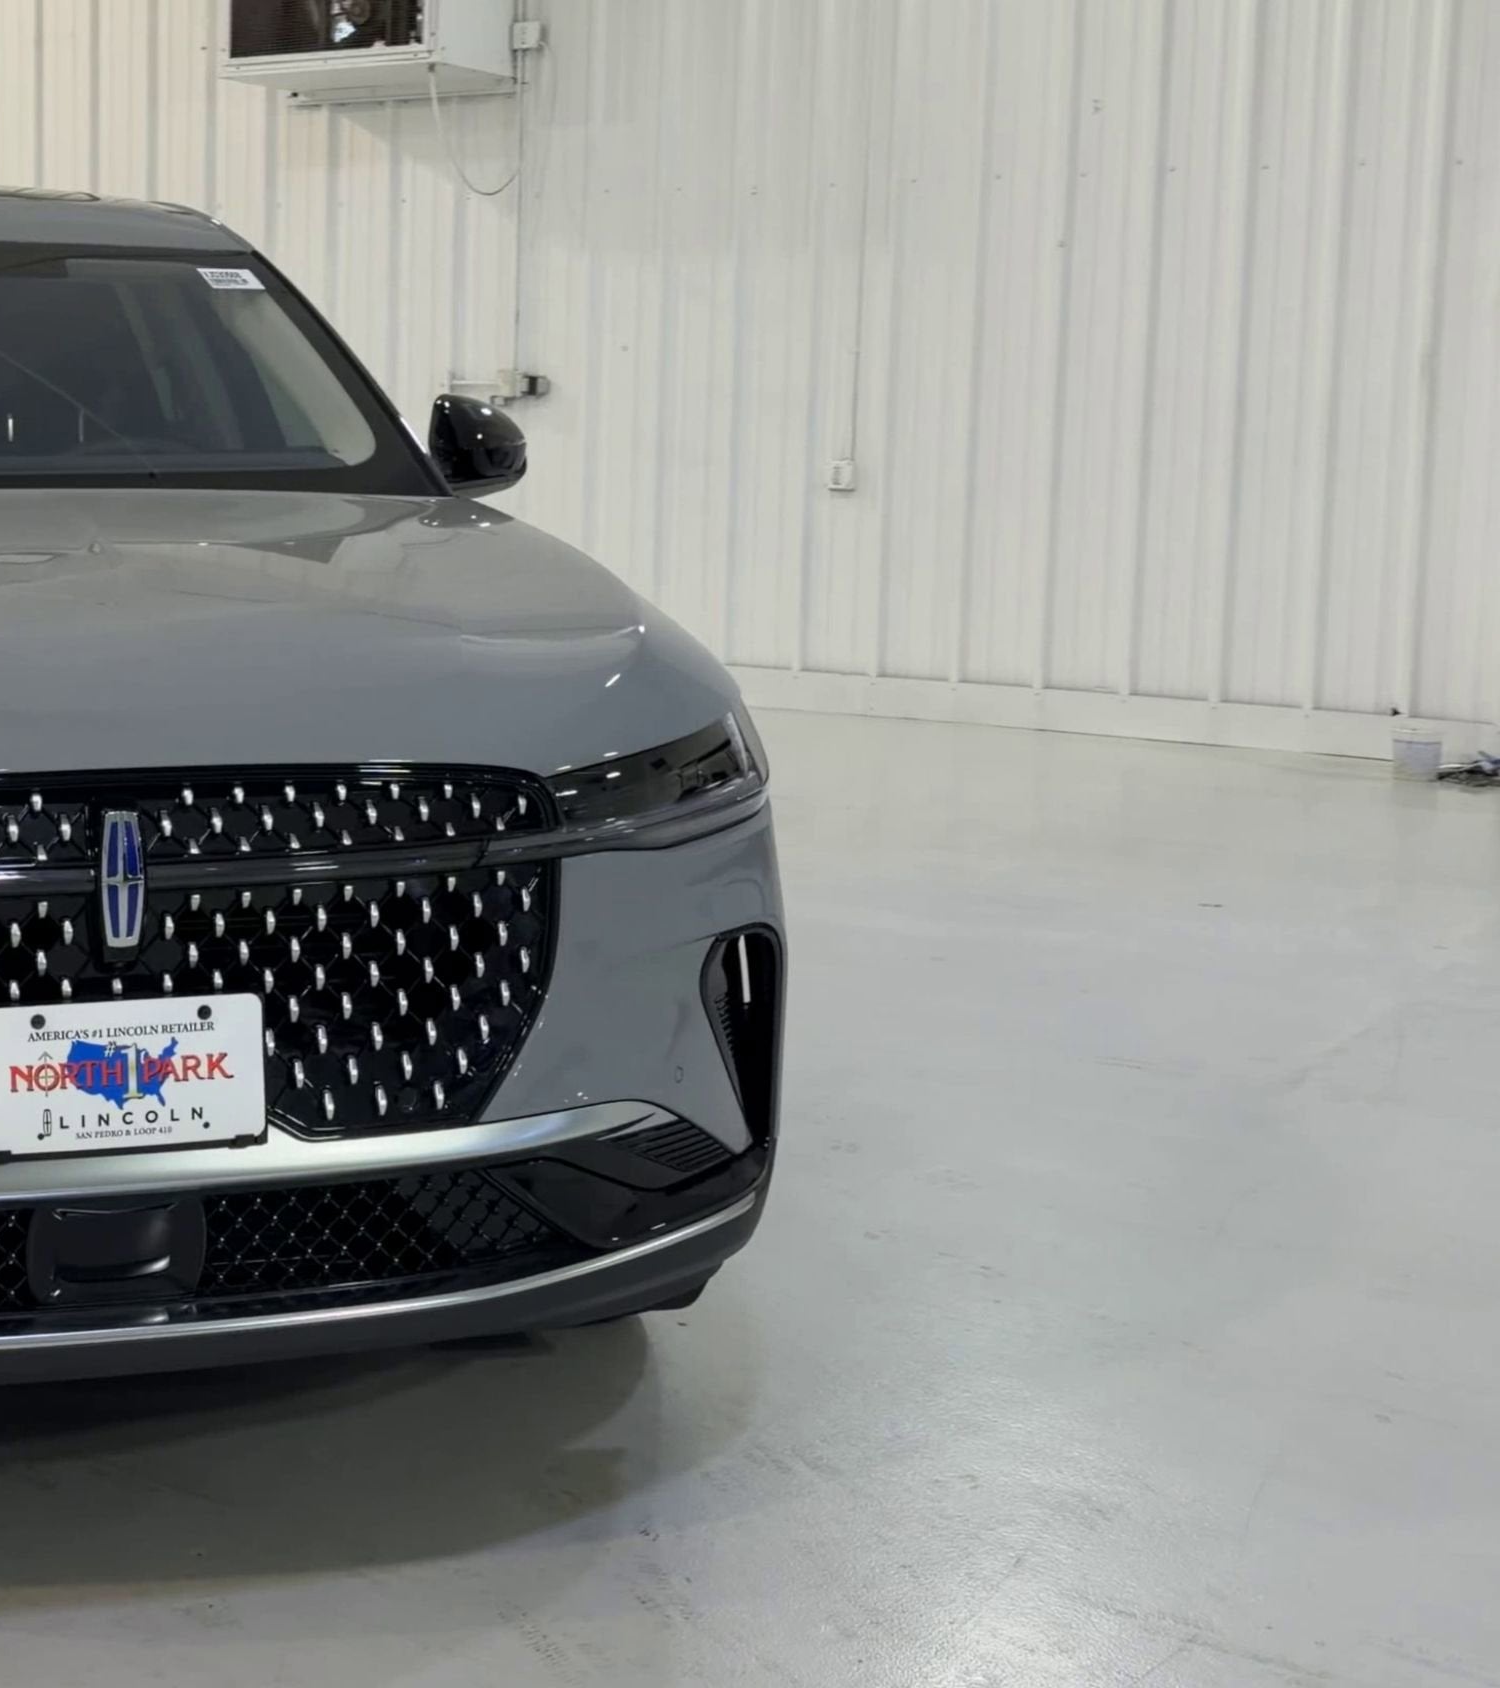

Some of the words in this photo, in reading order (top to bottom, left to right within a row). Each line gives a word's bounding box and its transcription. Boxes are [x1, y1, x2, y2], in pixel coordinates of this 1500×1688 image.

[27, 1028, 90, 1043] AMERICA'S
[91, 1028, 104, 1039] #1
[106, 1025, 159, 1038] LINCOLN
[160, 1021, 215, 1034] RETAILER
[9, 1060, 123, 1092] NORTH
[143, 1052, 235, 1083] PARK
[59, 1106, 204, 1129] LINCOLN
[75, 1132, 93, 1140] SAN
[94, 1130, 124, 1139] PEDRO
[133, 1127, 157, 1136] LOOP
